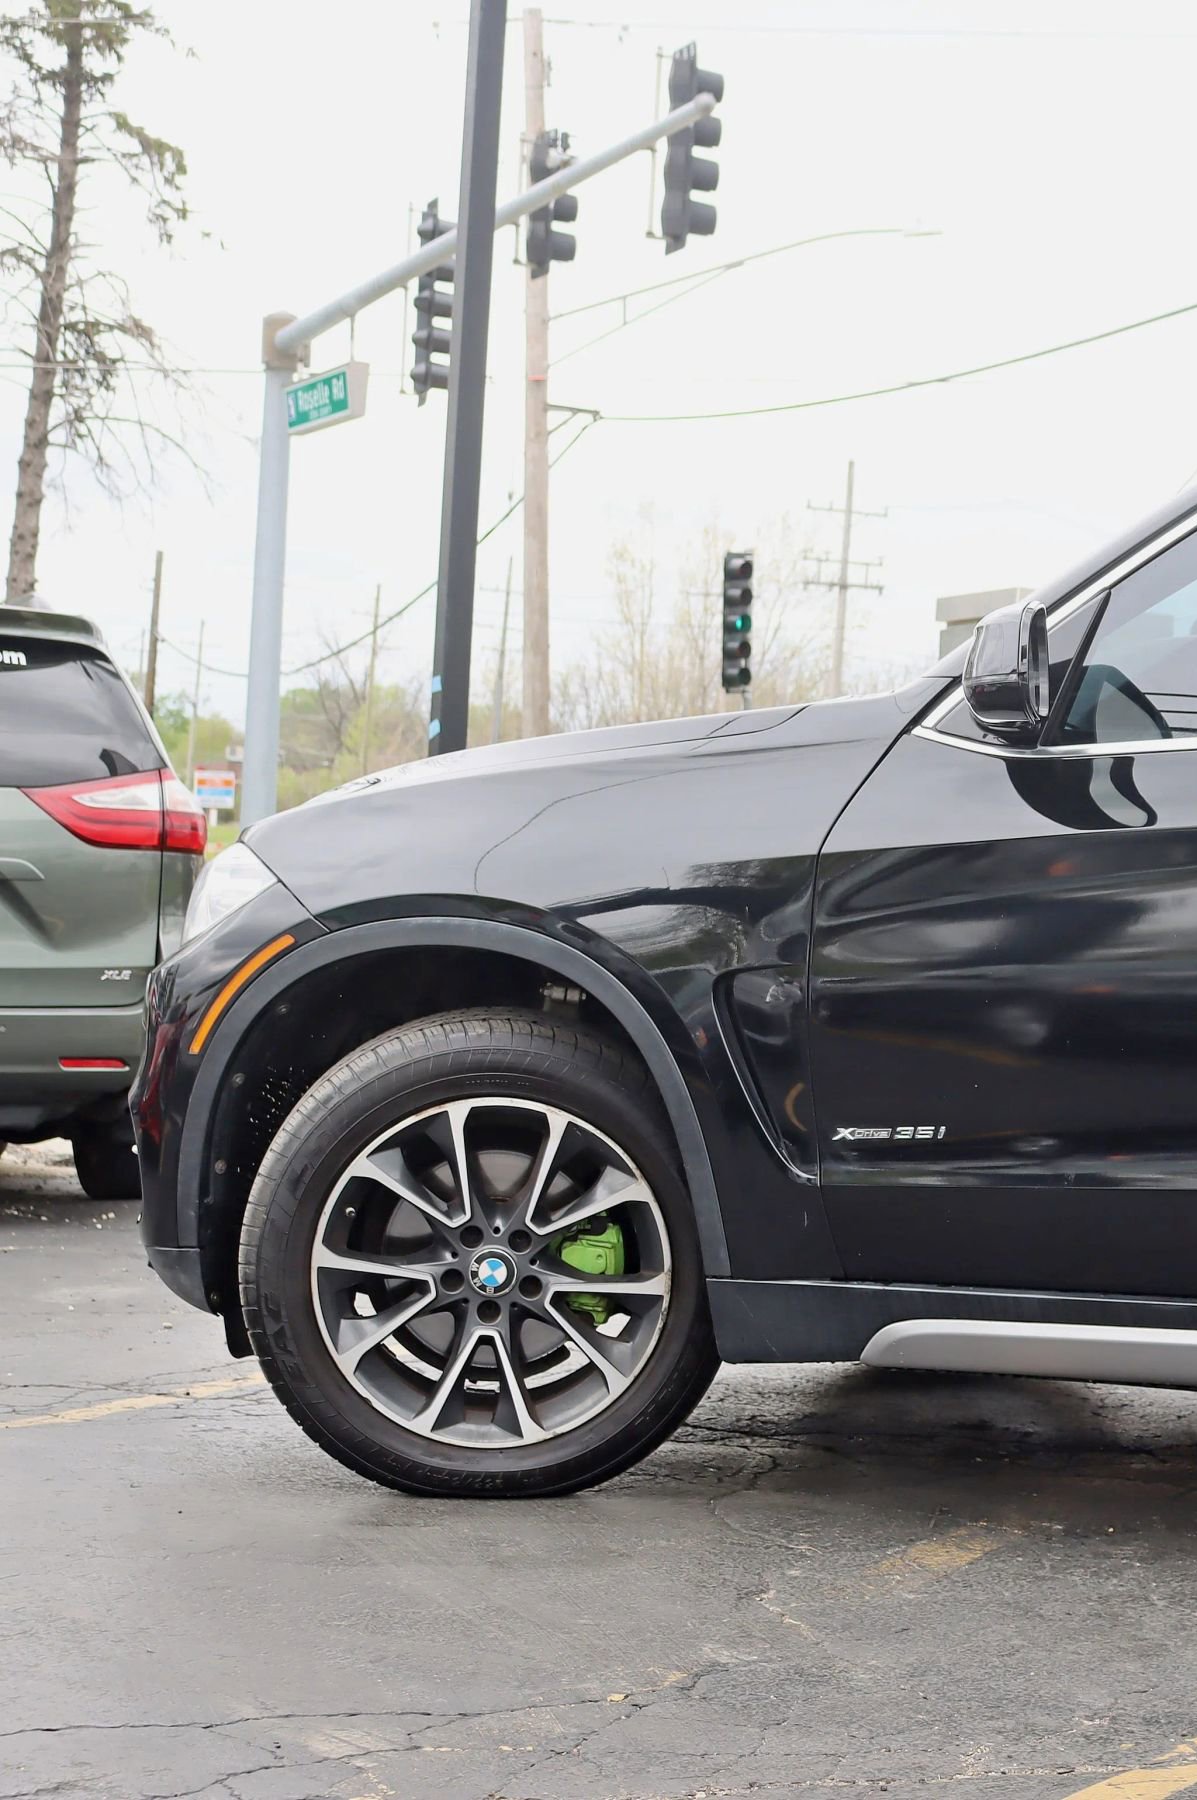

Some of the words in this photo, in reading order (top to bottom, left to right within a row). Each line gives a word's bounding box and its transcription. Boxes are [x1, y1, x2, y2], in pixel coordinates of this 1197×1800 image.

[297, 382, 330, 412] Roselle
[332, 375, 345, 400] Rd
[0, 650, 27, 666] m
[100, 969, 132, 981] XLE
